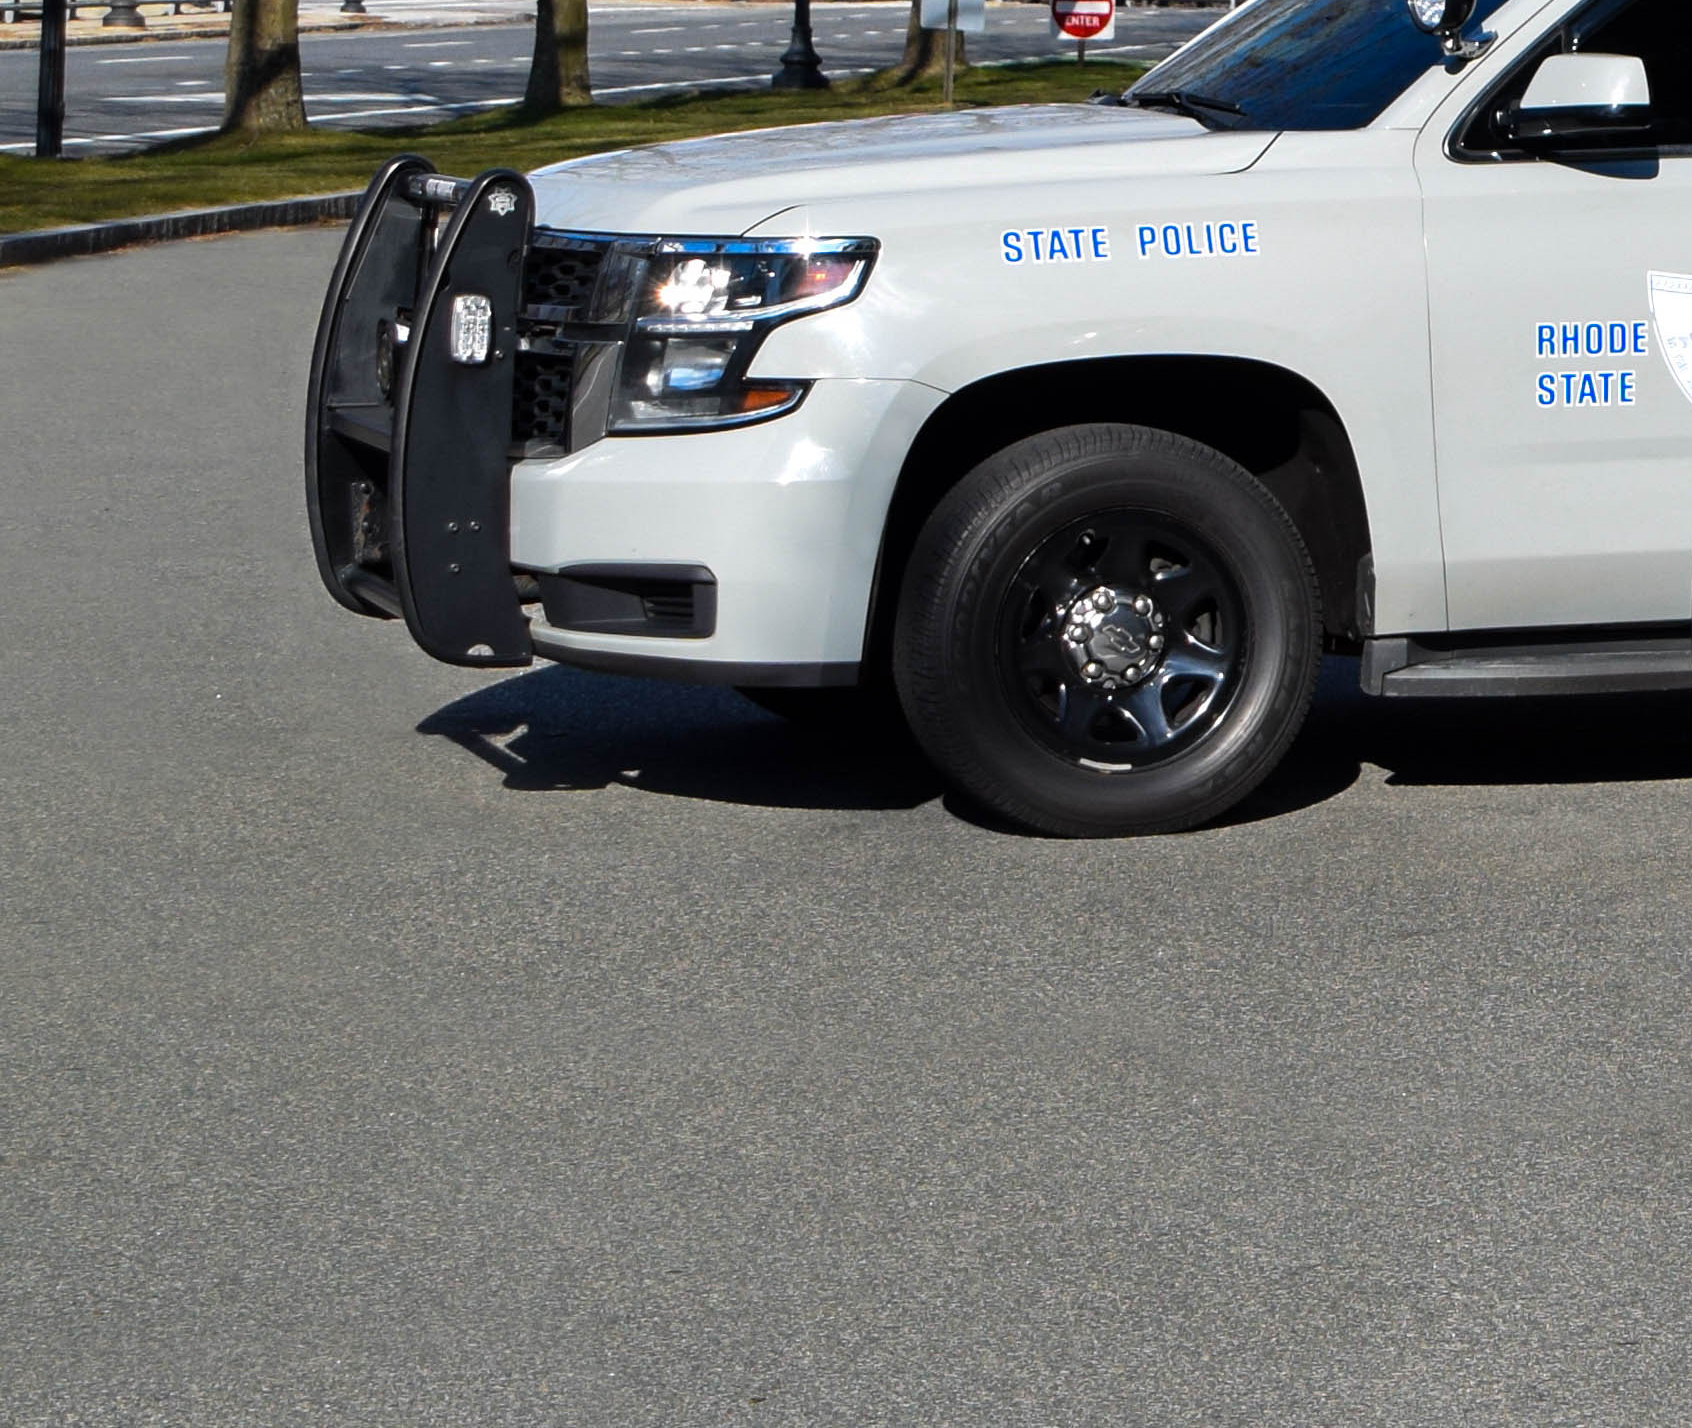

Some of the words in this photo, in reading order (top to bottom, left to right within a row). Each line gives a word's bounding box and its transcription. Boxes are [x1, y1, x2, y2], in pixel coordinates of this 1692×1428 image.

[1065, 14, 1100, 28] ENTER
[1002, 228, 1109, 263] STATE
[1138, 222, 1258, 256] POLICE
[1537, 322, 1648, 356] RHODE
[1537, 371, 1634, 405] STATE
